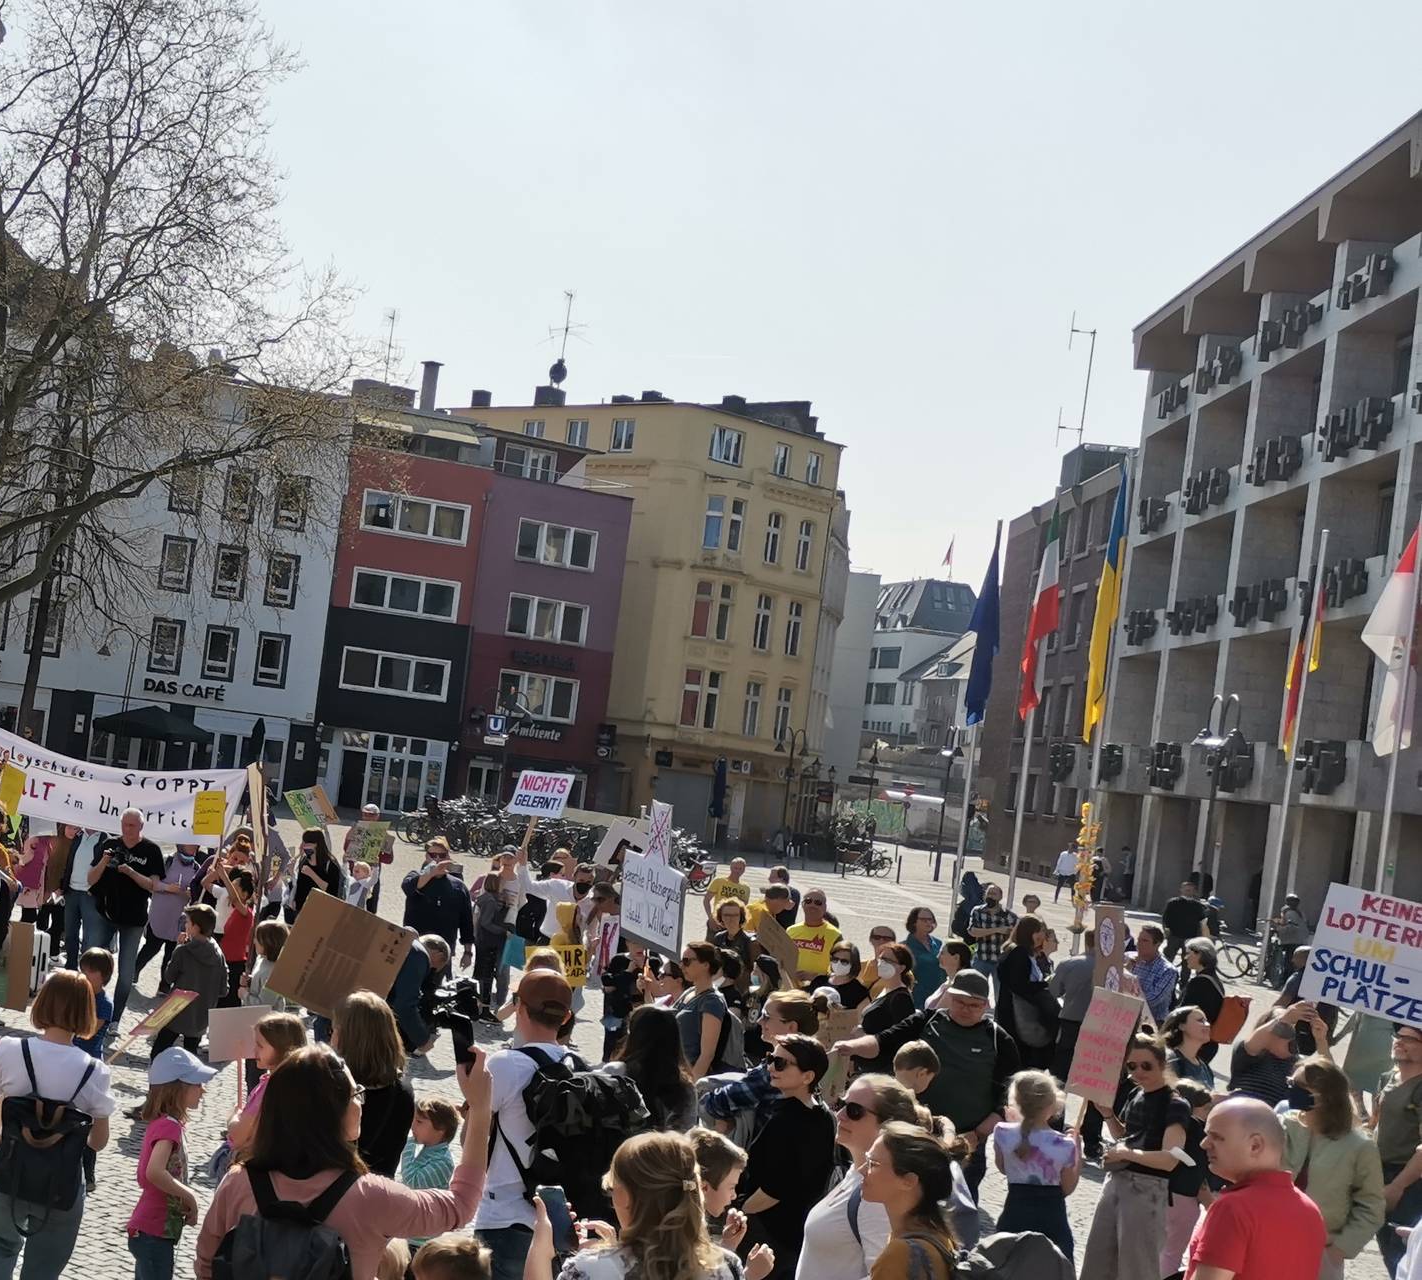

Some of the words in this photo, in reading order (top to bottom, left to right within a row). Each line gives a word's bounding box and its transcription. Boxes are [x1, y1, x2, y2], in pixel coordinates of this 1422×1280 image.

[143, 678, 178, 695] DAS
[182, 683, 226, 702] CAFÉ
[489, 718, 503, 731] U
[509, 720, 561, 742] Ambiente
[122, 774, 215, 793] STOPPT
[520, 774, 568, 794] NICHTS
[65, 794, 83, 810] im
[514, 794, 562, 810] GELERNT!
[1361, 893, 1422, 924] KEINE
[1354, 938, 1396, 963] UM
[1311, 949, 1410, 989] SCHUL-
[1321, 977, 1422, 1023] PLÄTZE
